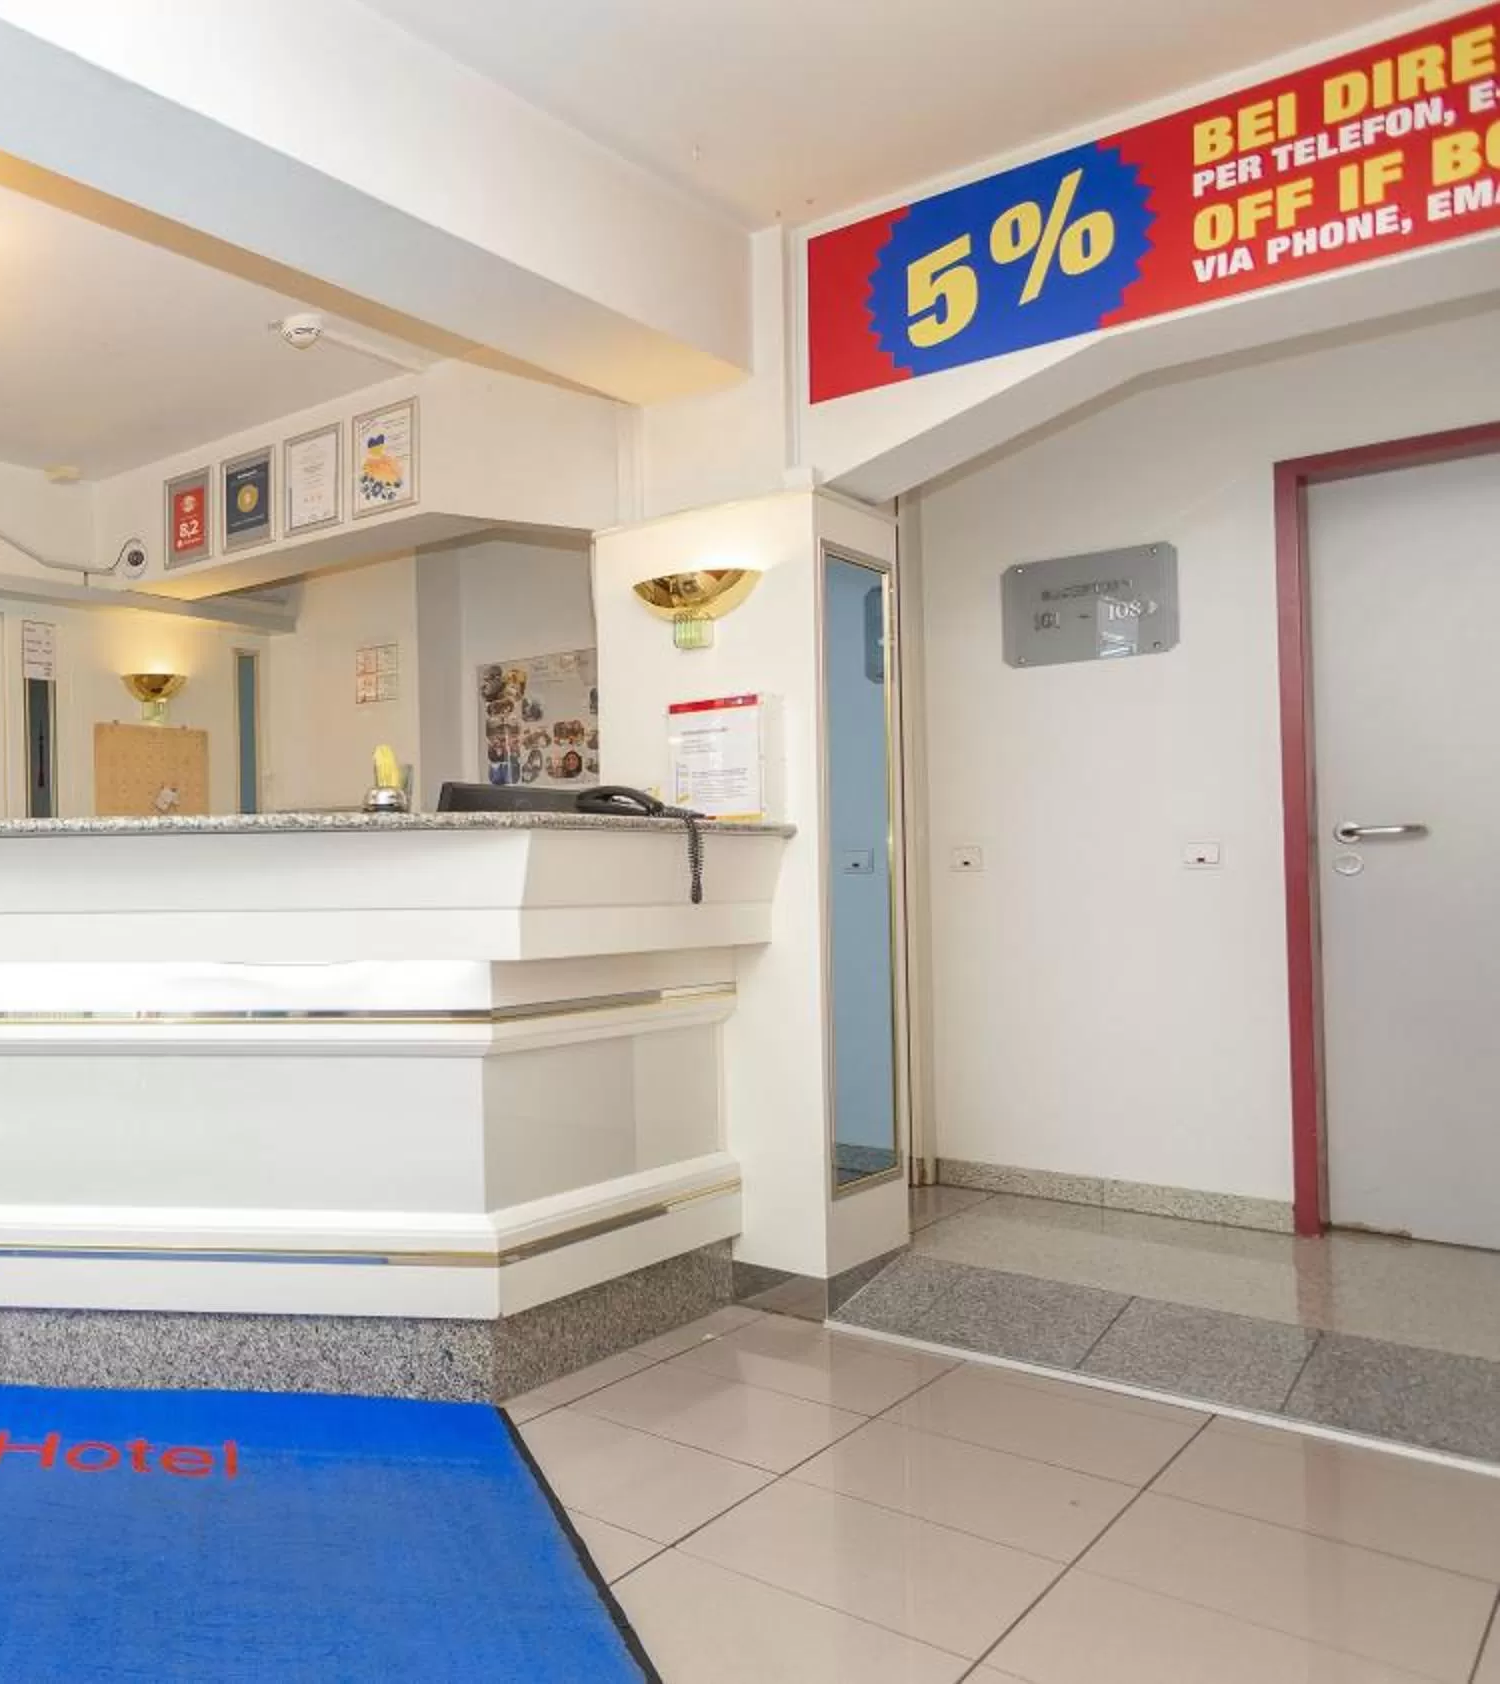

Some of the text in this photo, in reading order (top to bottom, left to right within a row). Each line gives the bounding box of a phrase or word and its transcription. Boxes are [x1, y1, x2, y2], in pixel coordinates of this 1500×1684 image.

[1193, 24, 1496, 166] BEI DIRE
[1193, 154, 1263, 198] PER
[1271, 96, 1457, 172] TELEFON,
[1192, 178, 1500, 283] VIA PHONE, EM
[1193, 177, 1313, 251] OFF
[1339, 150, 1404, 213] IF
[907, 168, 1115, 349] 5%
